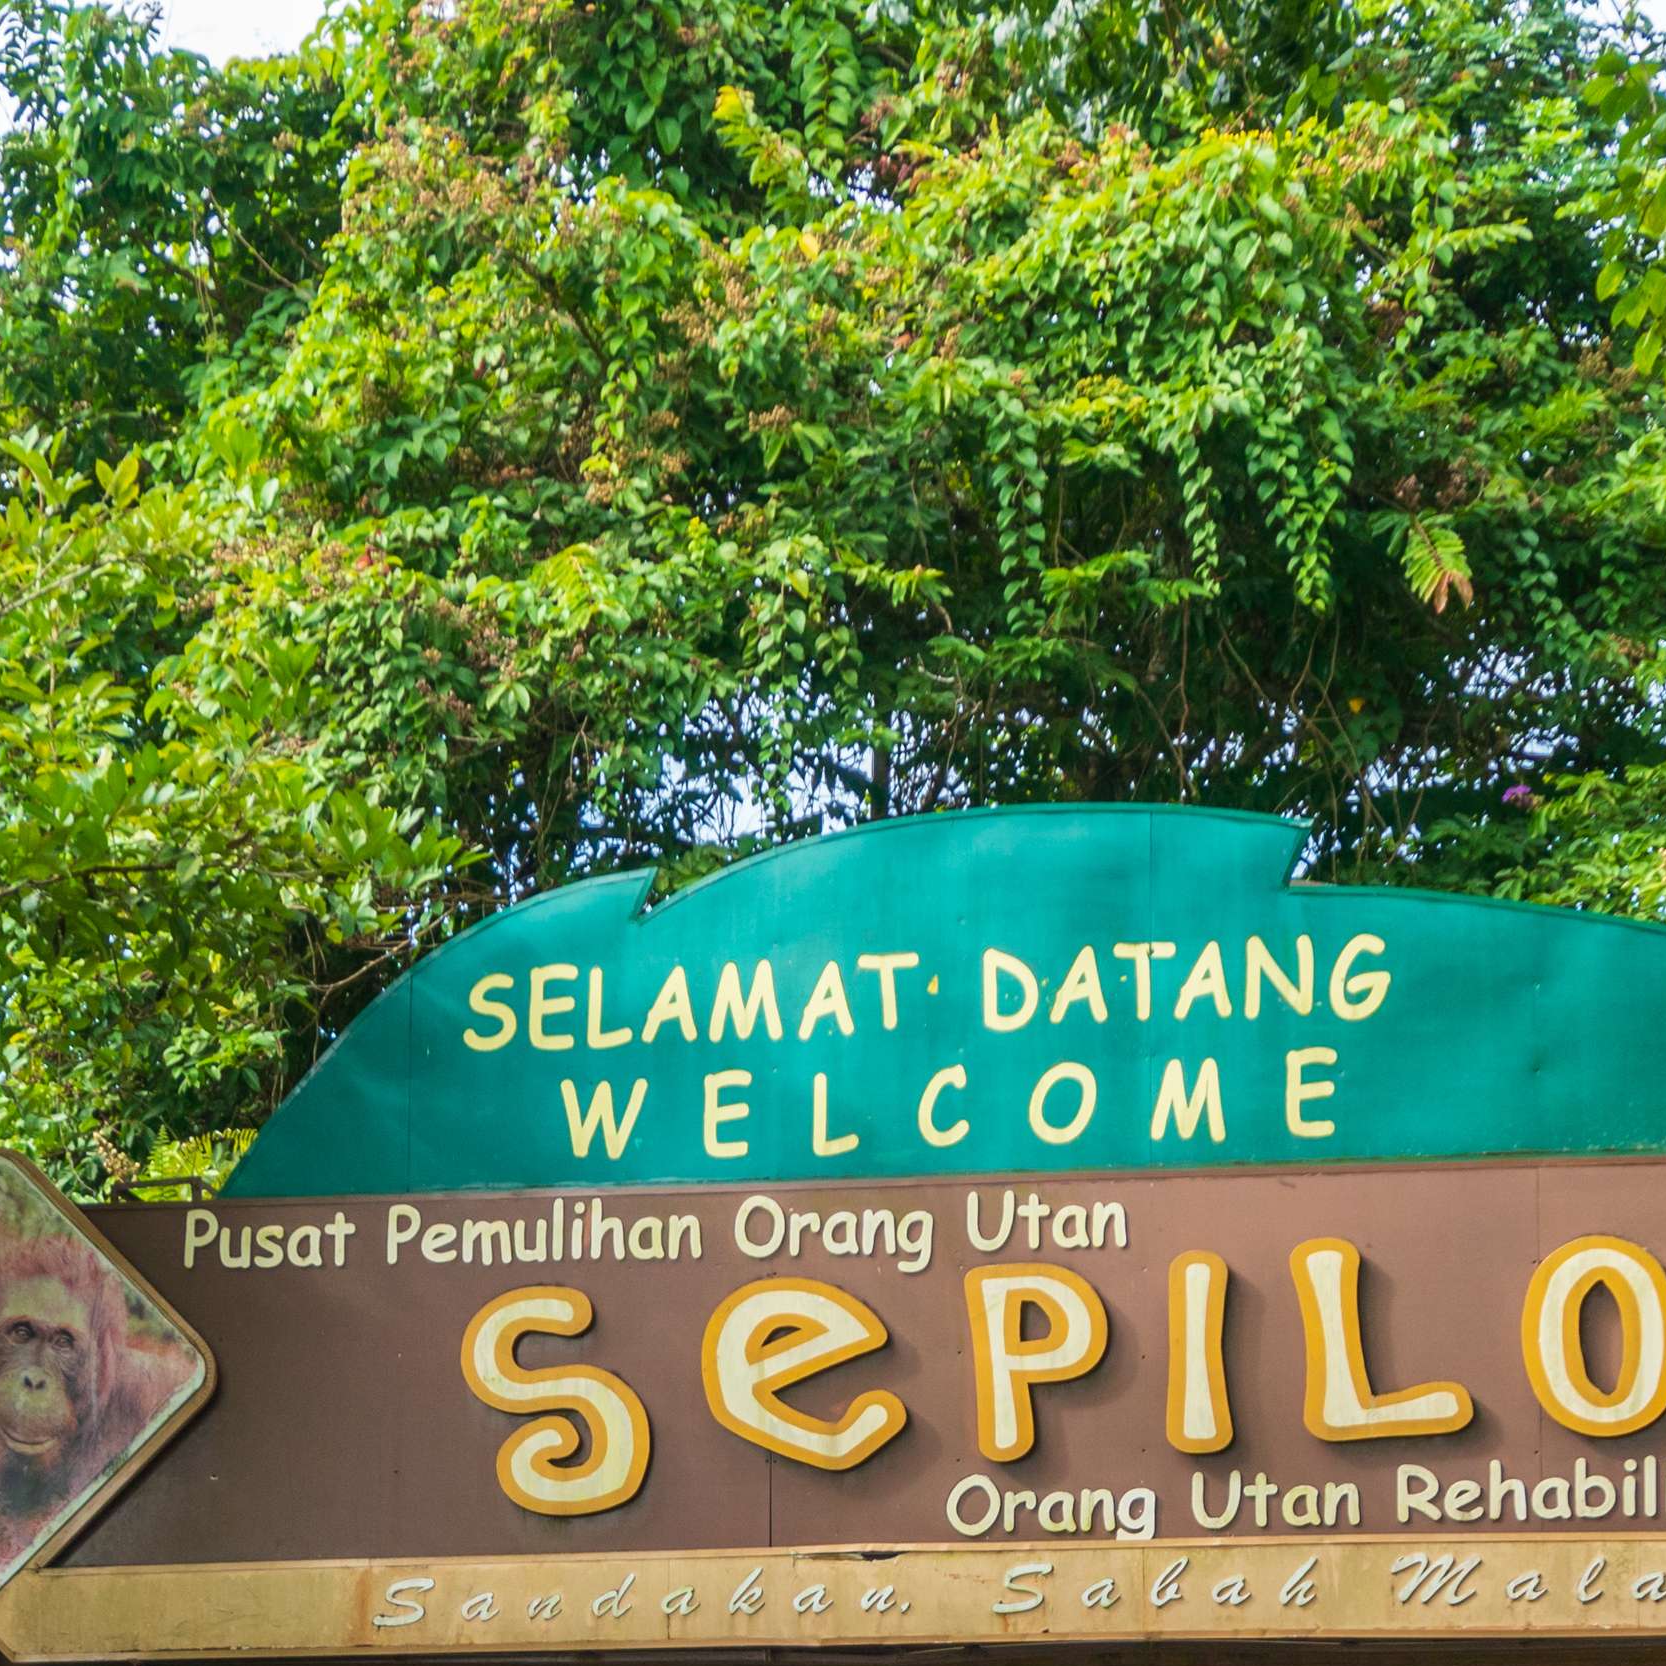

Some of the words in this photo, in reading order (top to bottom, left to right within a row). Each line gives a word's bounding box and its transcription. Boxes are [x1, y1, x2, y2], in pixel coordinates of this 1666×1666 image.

[463, 951, 920, 1052] SELAMAT
[982, 933, 1391, 1032] DATANG
[560, 1046, 1338, 1160] WELCOME
[183, 1206, 356, 1269] Pusat
[386, 1197, 702, 1265] Pemulihan
[733, 1194, 934, 1273] Orang
[966, 1189, 1130, 1252] Utan
[944, 1473, 1159, 1541] Orang
[1190, 1470, 1362, 1530] Utan
[991, 1555, 1319, 1615] Sabah
